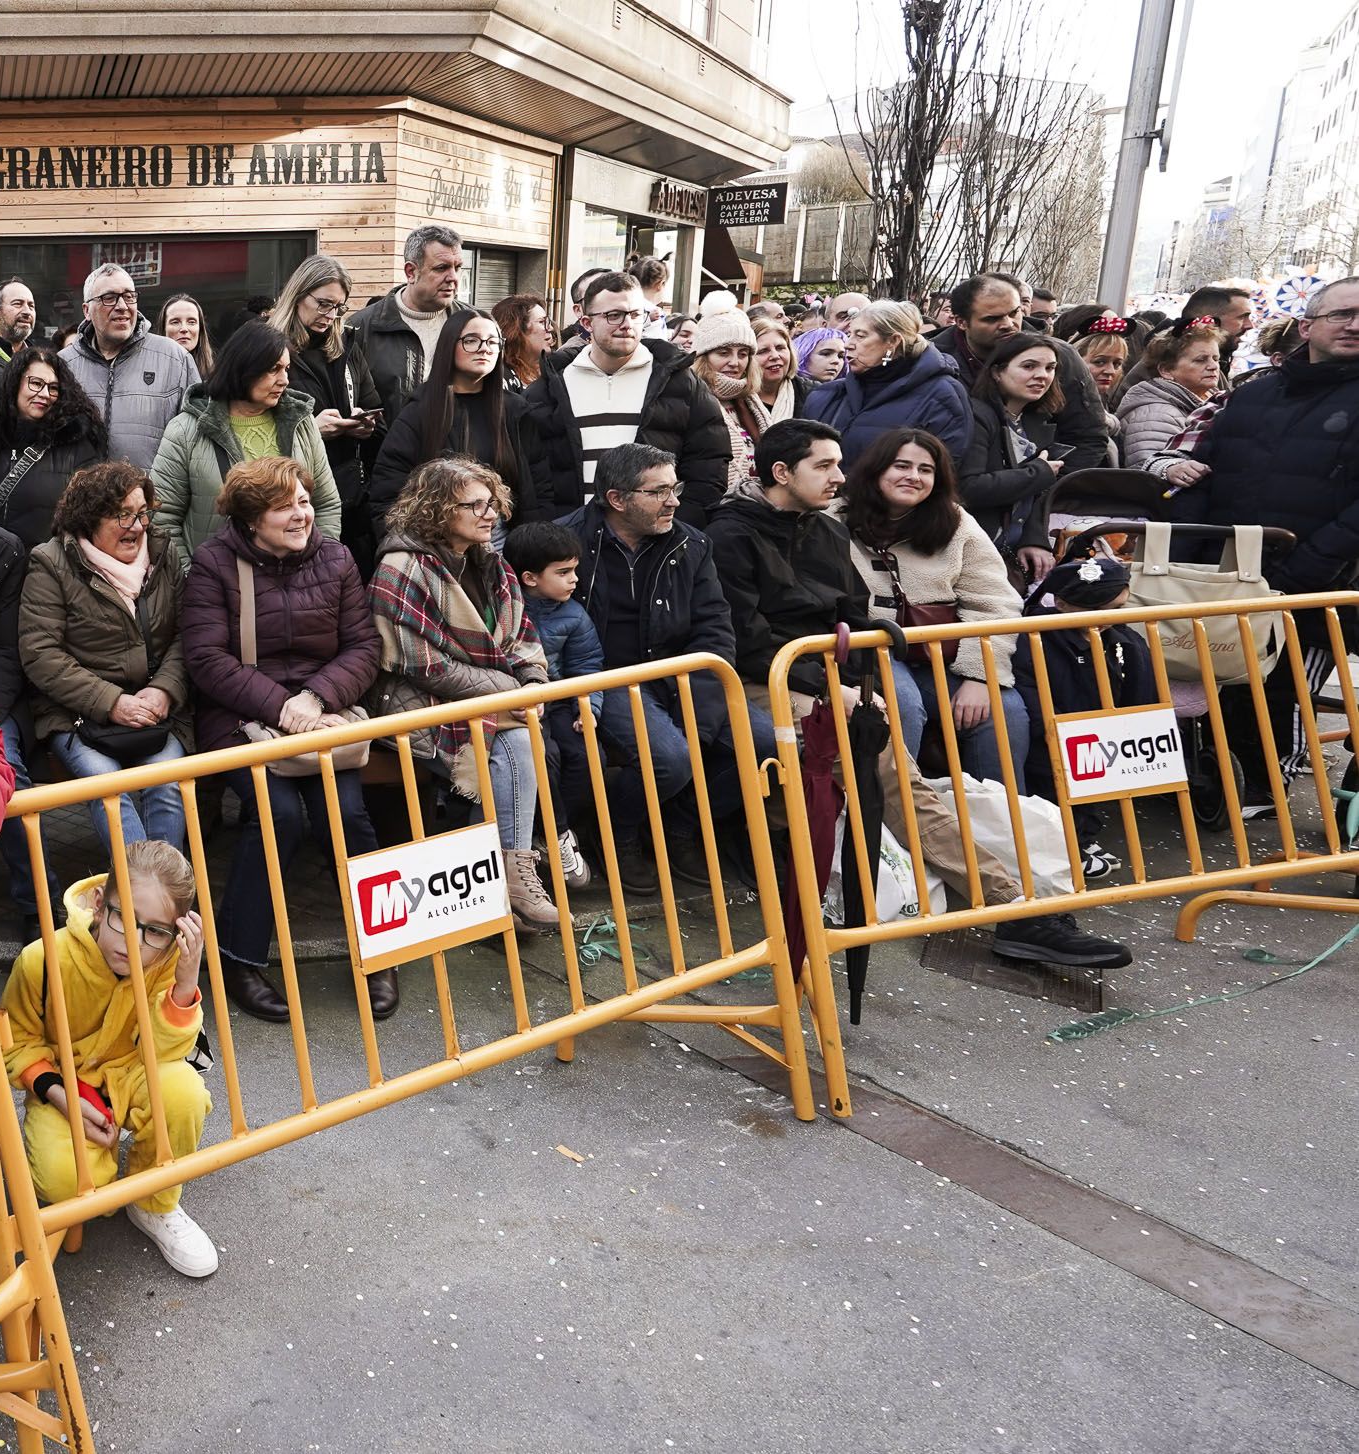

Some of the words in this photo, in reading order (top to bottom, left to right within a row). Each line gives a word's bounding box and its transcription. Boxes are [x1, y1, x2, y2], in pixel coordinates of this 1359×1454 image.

[186, 143, 235, 188] DE
[246, 141, 388, 186] AMELIA
[719, 208, 770, 218] CAFÉ-BAR
[720, 200, 770, 211] PANADERÍA
[719, 215, 769, 225] PASTELERÍA
[1076, 728, 1179, 776] Myagal
[1121, 762, 1168, 775] ALQUILER
[370, 850, 500, 929] Myagal
[427, 895, 486, 919] ALQUILER
